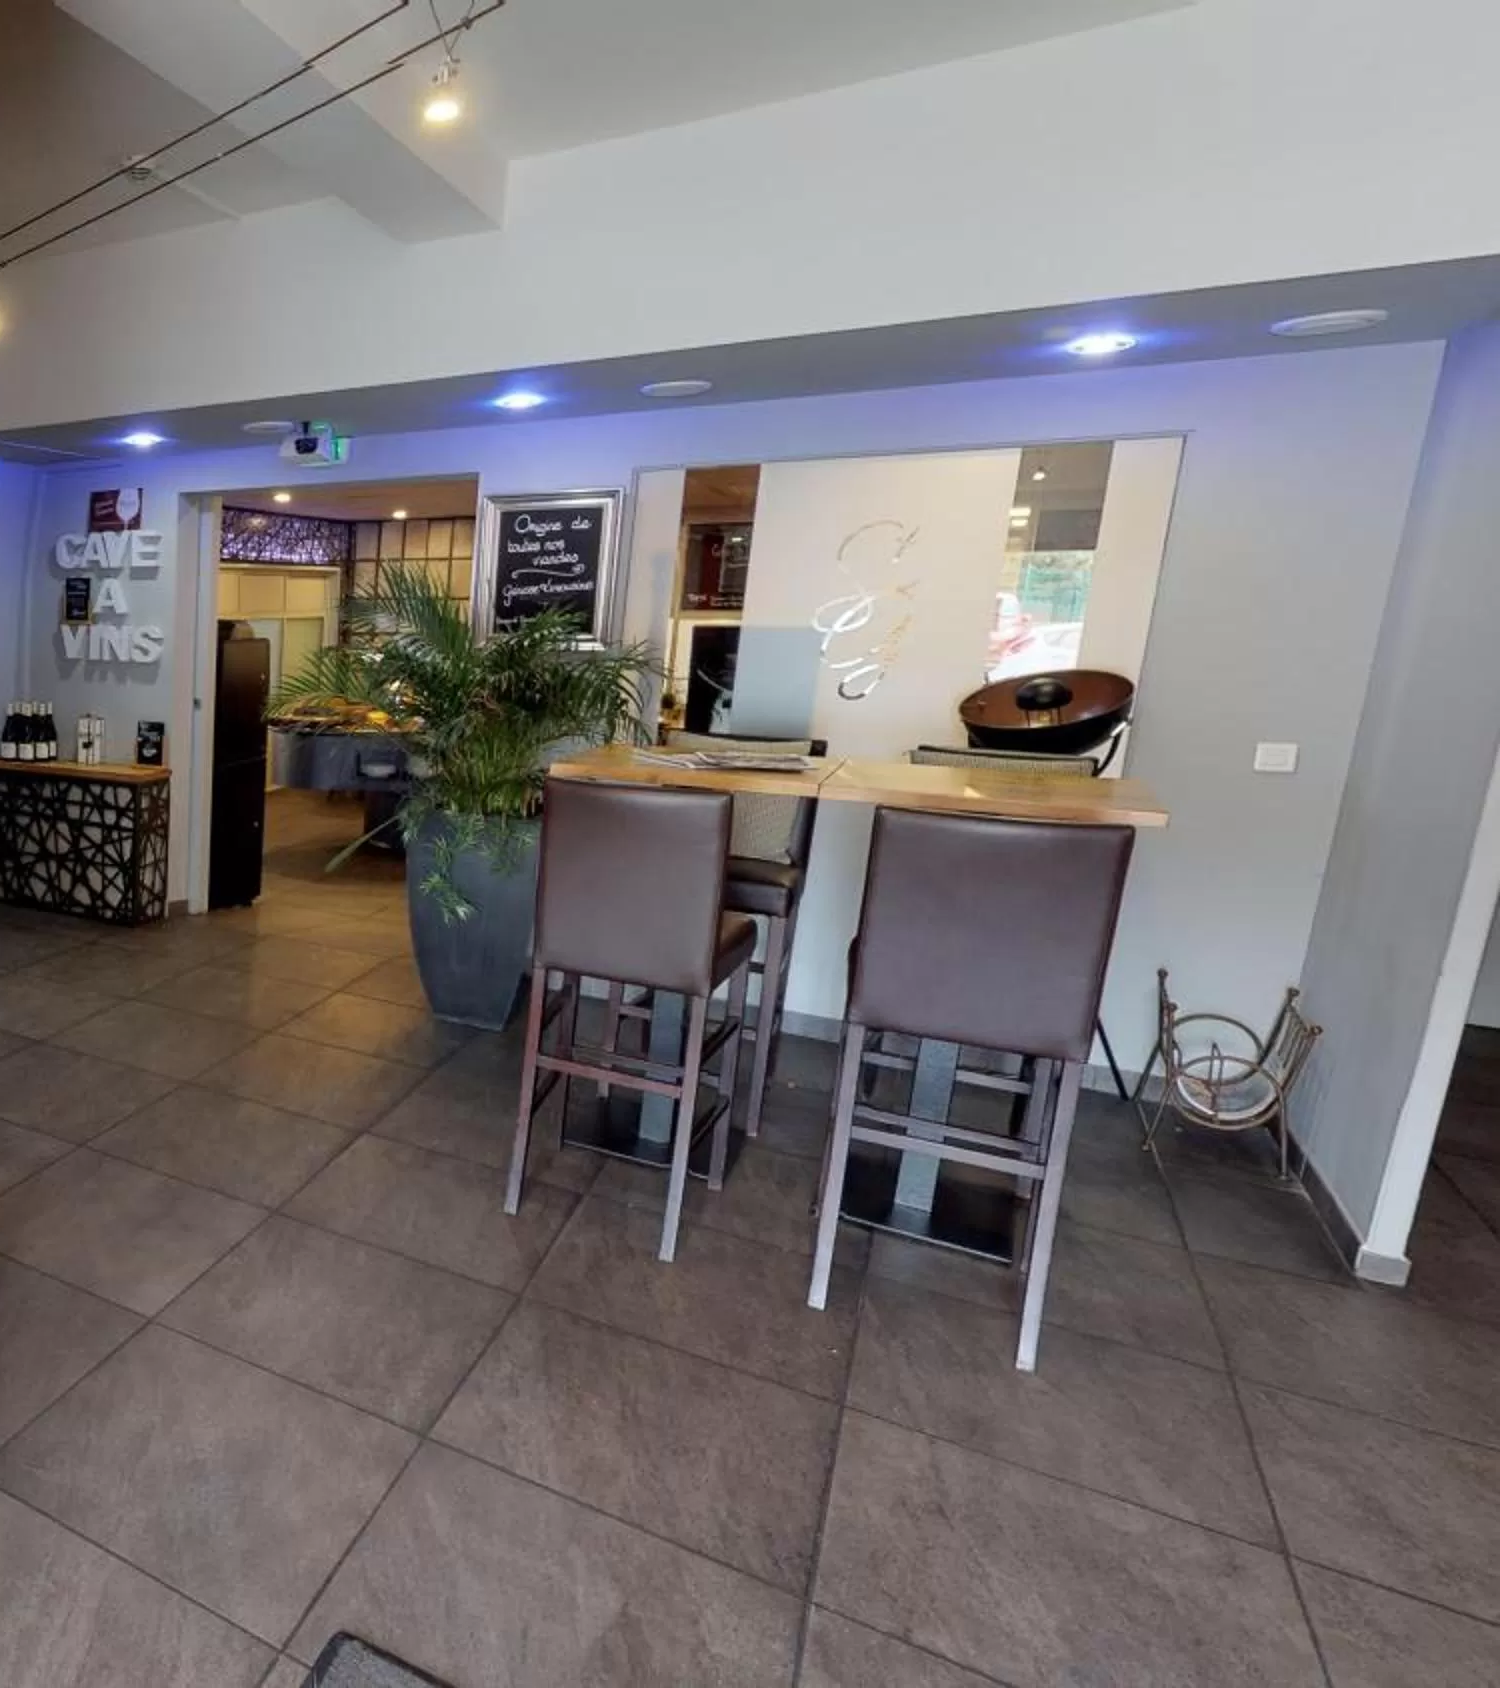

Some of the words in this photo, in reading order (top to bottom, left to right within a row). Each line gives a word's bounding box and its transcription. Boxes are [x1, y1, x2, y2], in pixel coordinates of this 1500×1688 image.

[571, 516, 592, 529] de
[56, 530, 164, 569] CAVE
[60, 624, 165, 664] VINS
